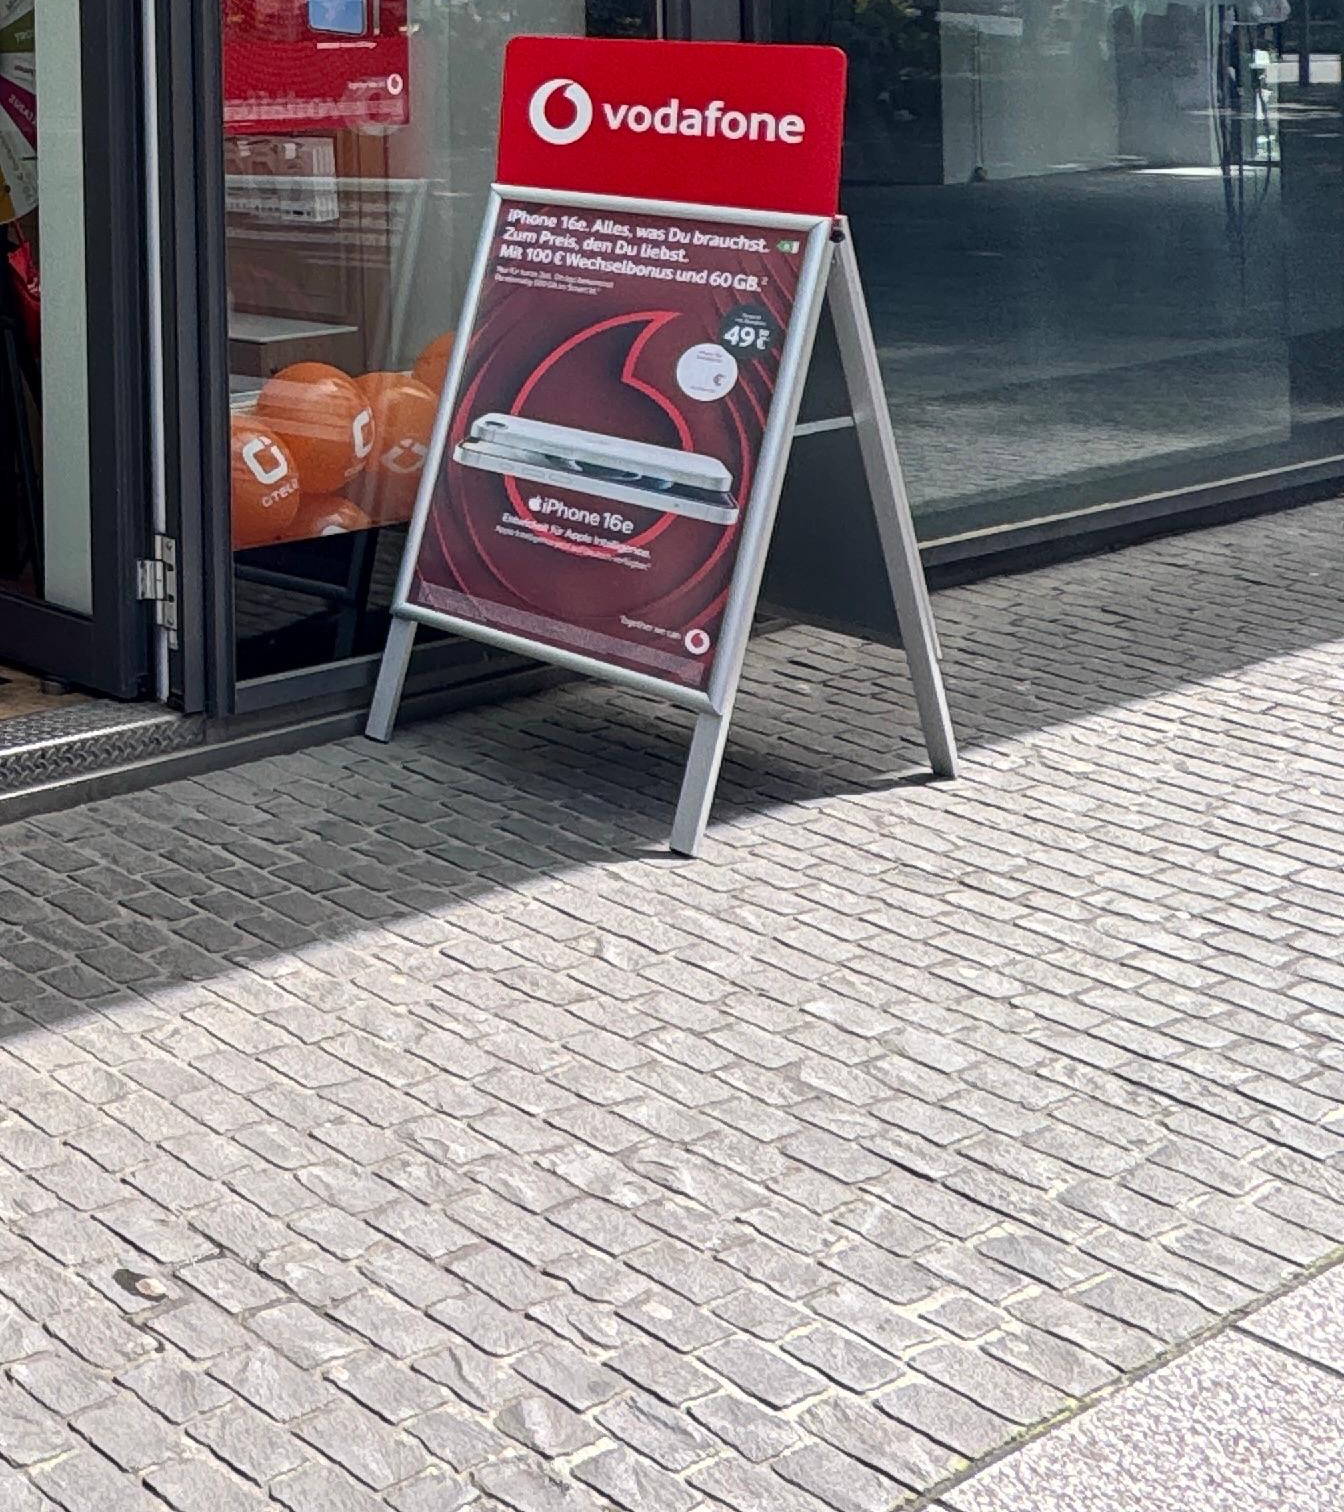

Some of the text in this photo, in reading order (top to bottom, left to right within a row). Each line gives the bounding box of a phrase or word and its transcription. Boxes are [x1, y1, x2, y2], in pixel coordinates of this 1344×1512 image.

[601, 98, 806, 144] vodafone
[502, 227, 537, 244] Zum
[582, 236, 612, 253] den
[615, 240, 638, 256] Du
[641, 244, 690, 263] liebst.
[507, 208, 558, 229] iPhone
[592, 218, 632, 239] Alles,
[636, 226, 666, 241] was
[668, 228, 691, 244] Du
[693, 230, 771, 253] brauchst.
[499, 244, 523, 260] Mit
[526, 247, 551, 264] 100
[564, 251, 674, 280] Wechselbonus
[675, 265, 707, 283] und
[708, 271, 731, 288] 60
[541, 497, 635, 535] iPhone 16e
